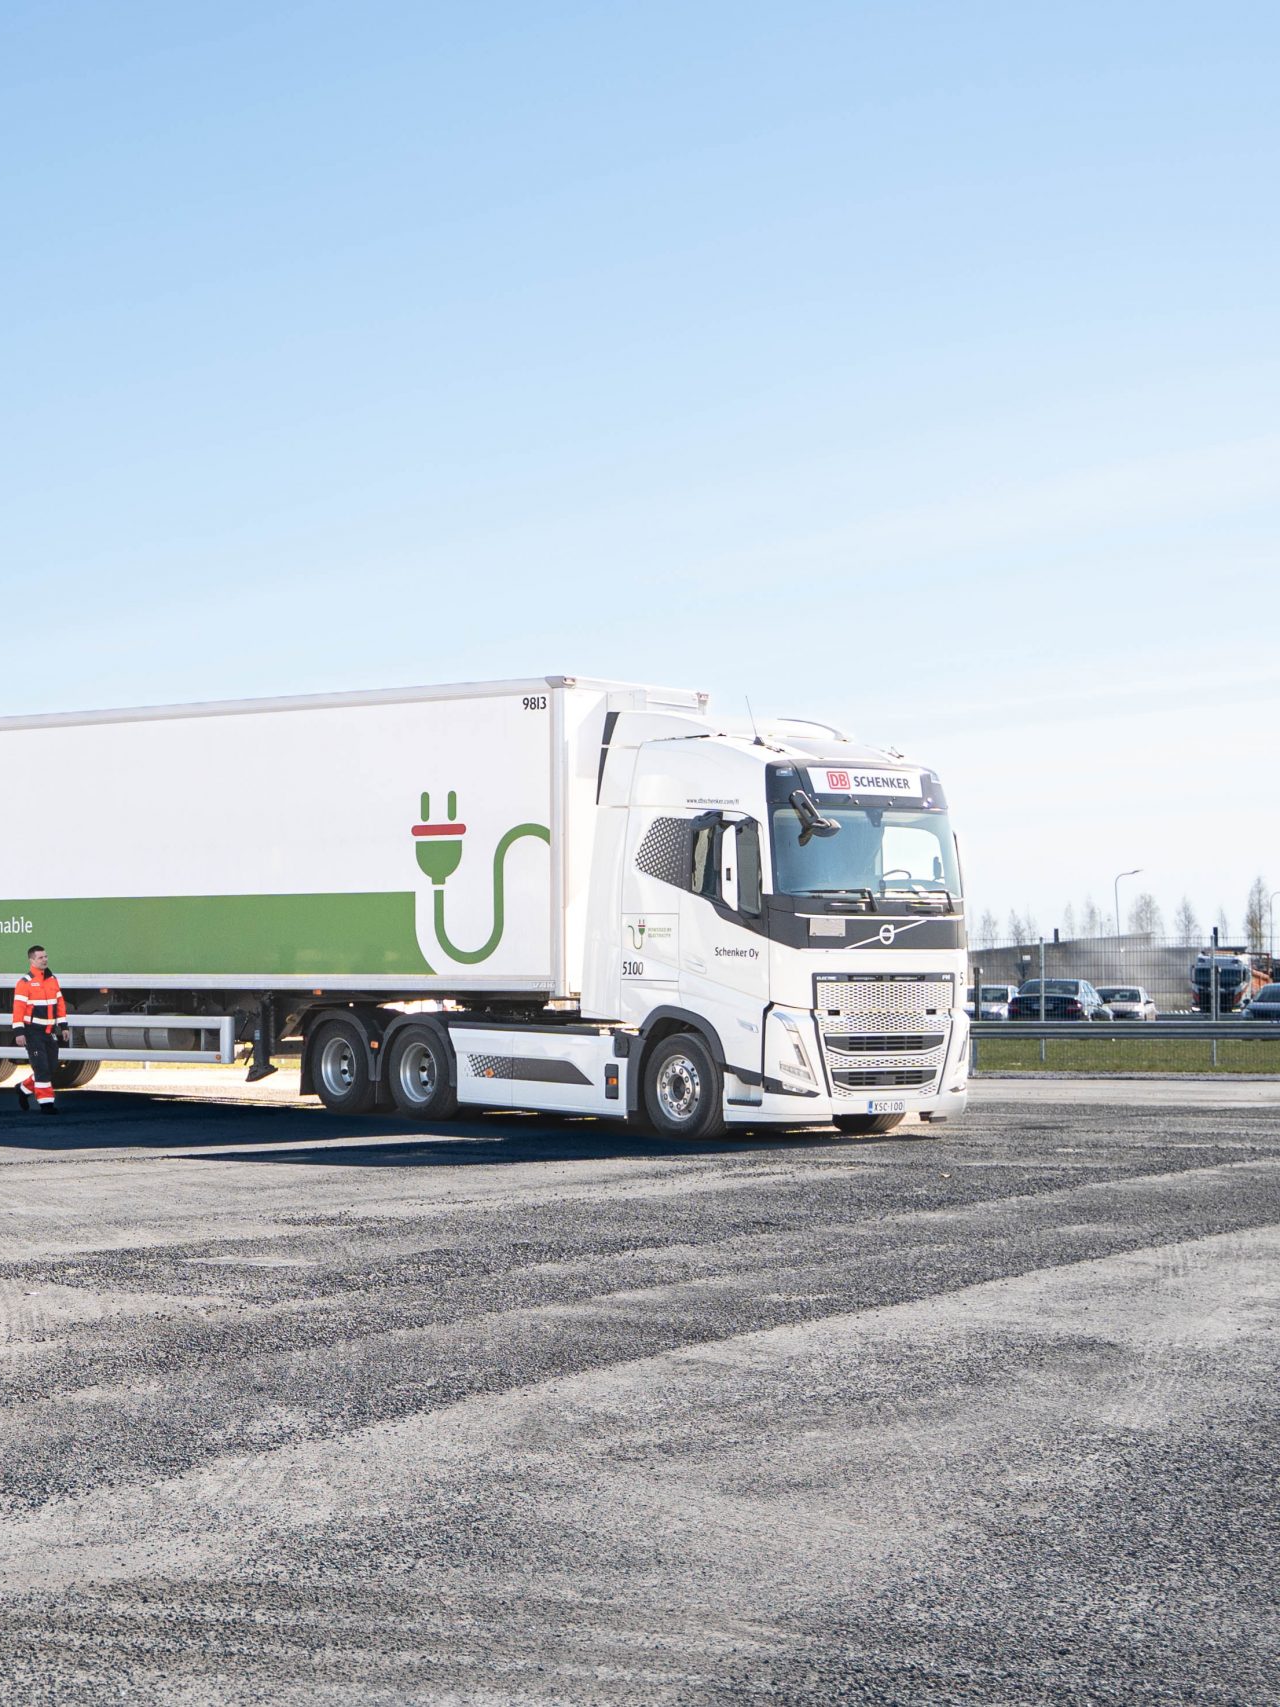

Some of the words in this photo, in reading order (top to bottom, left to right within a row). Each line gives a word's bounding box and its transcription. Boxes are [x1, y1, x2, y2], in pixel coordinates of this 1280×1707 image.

[522, 696, 547, 710] 9813
[829, 773, 848, 787] DB
[853, 776, 911, 789] SCHENKER
[714, 946, 747, 957] Schenker
[748, 948, 760, 959] Oy
[622, 961, 644, 975] 5100
[874, 1102, 903, 1111] XSC-100
